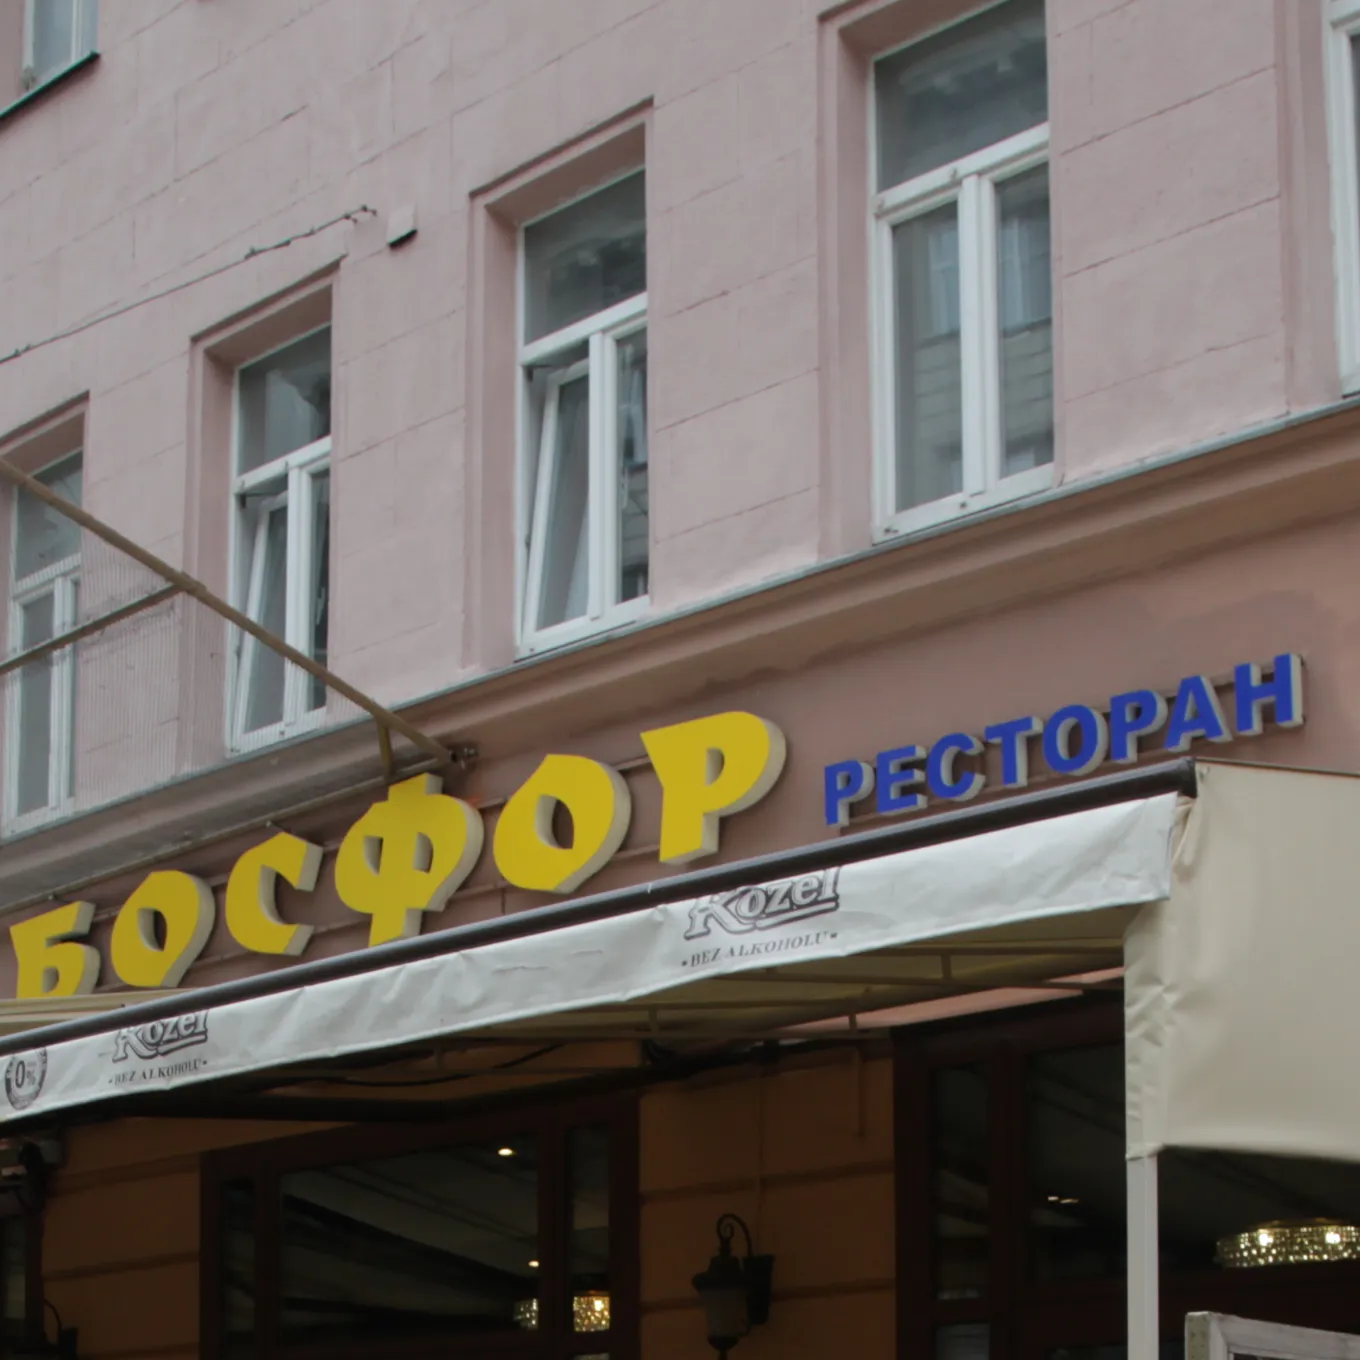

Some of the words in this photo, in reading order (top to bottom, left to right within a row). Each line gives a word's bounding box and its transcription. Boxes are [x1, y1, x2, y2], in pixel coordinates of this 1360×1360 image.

[824, 652, 1305, 826] РЕСТОРАН
[10, 711, 786, 999] БОСФОР
[683, 866, 840, 940] Kozel
[691, 947, 721, 968] BEZ
[726, 932, 828, 958] ALKOHOLU
